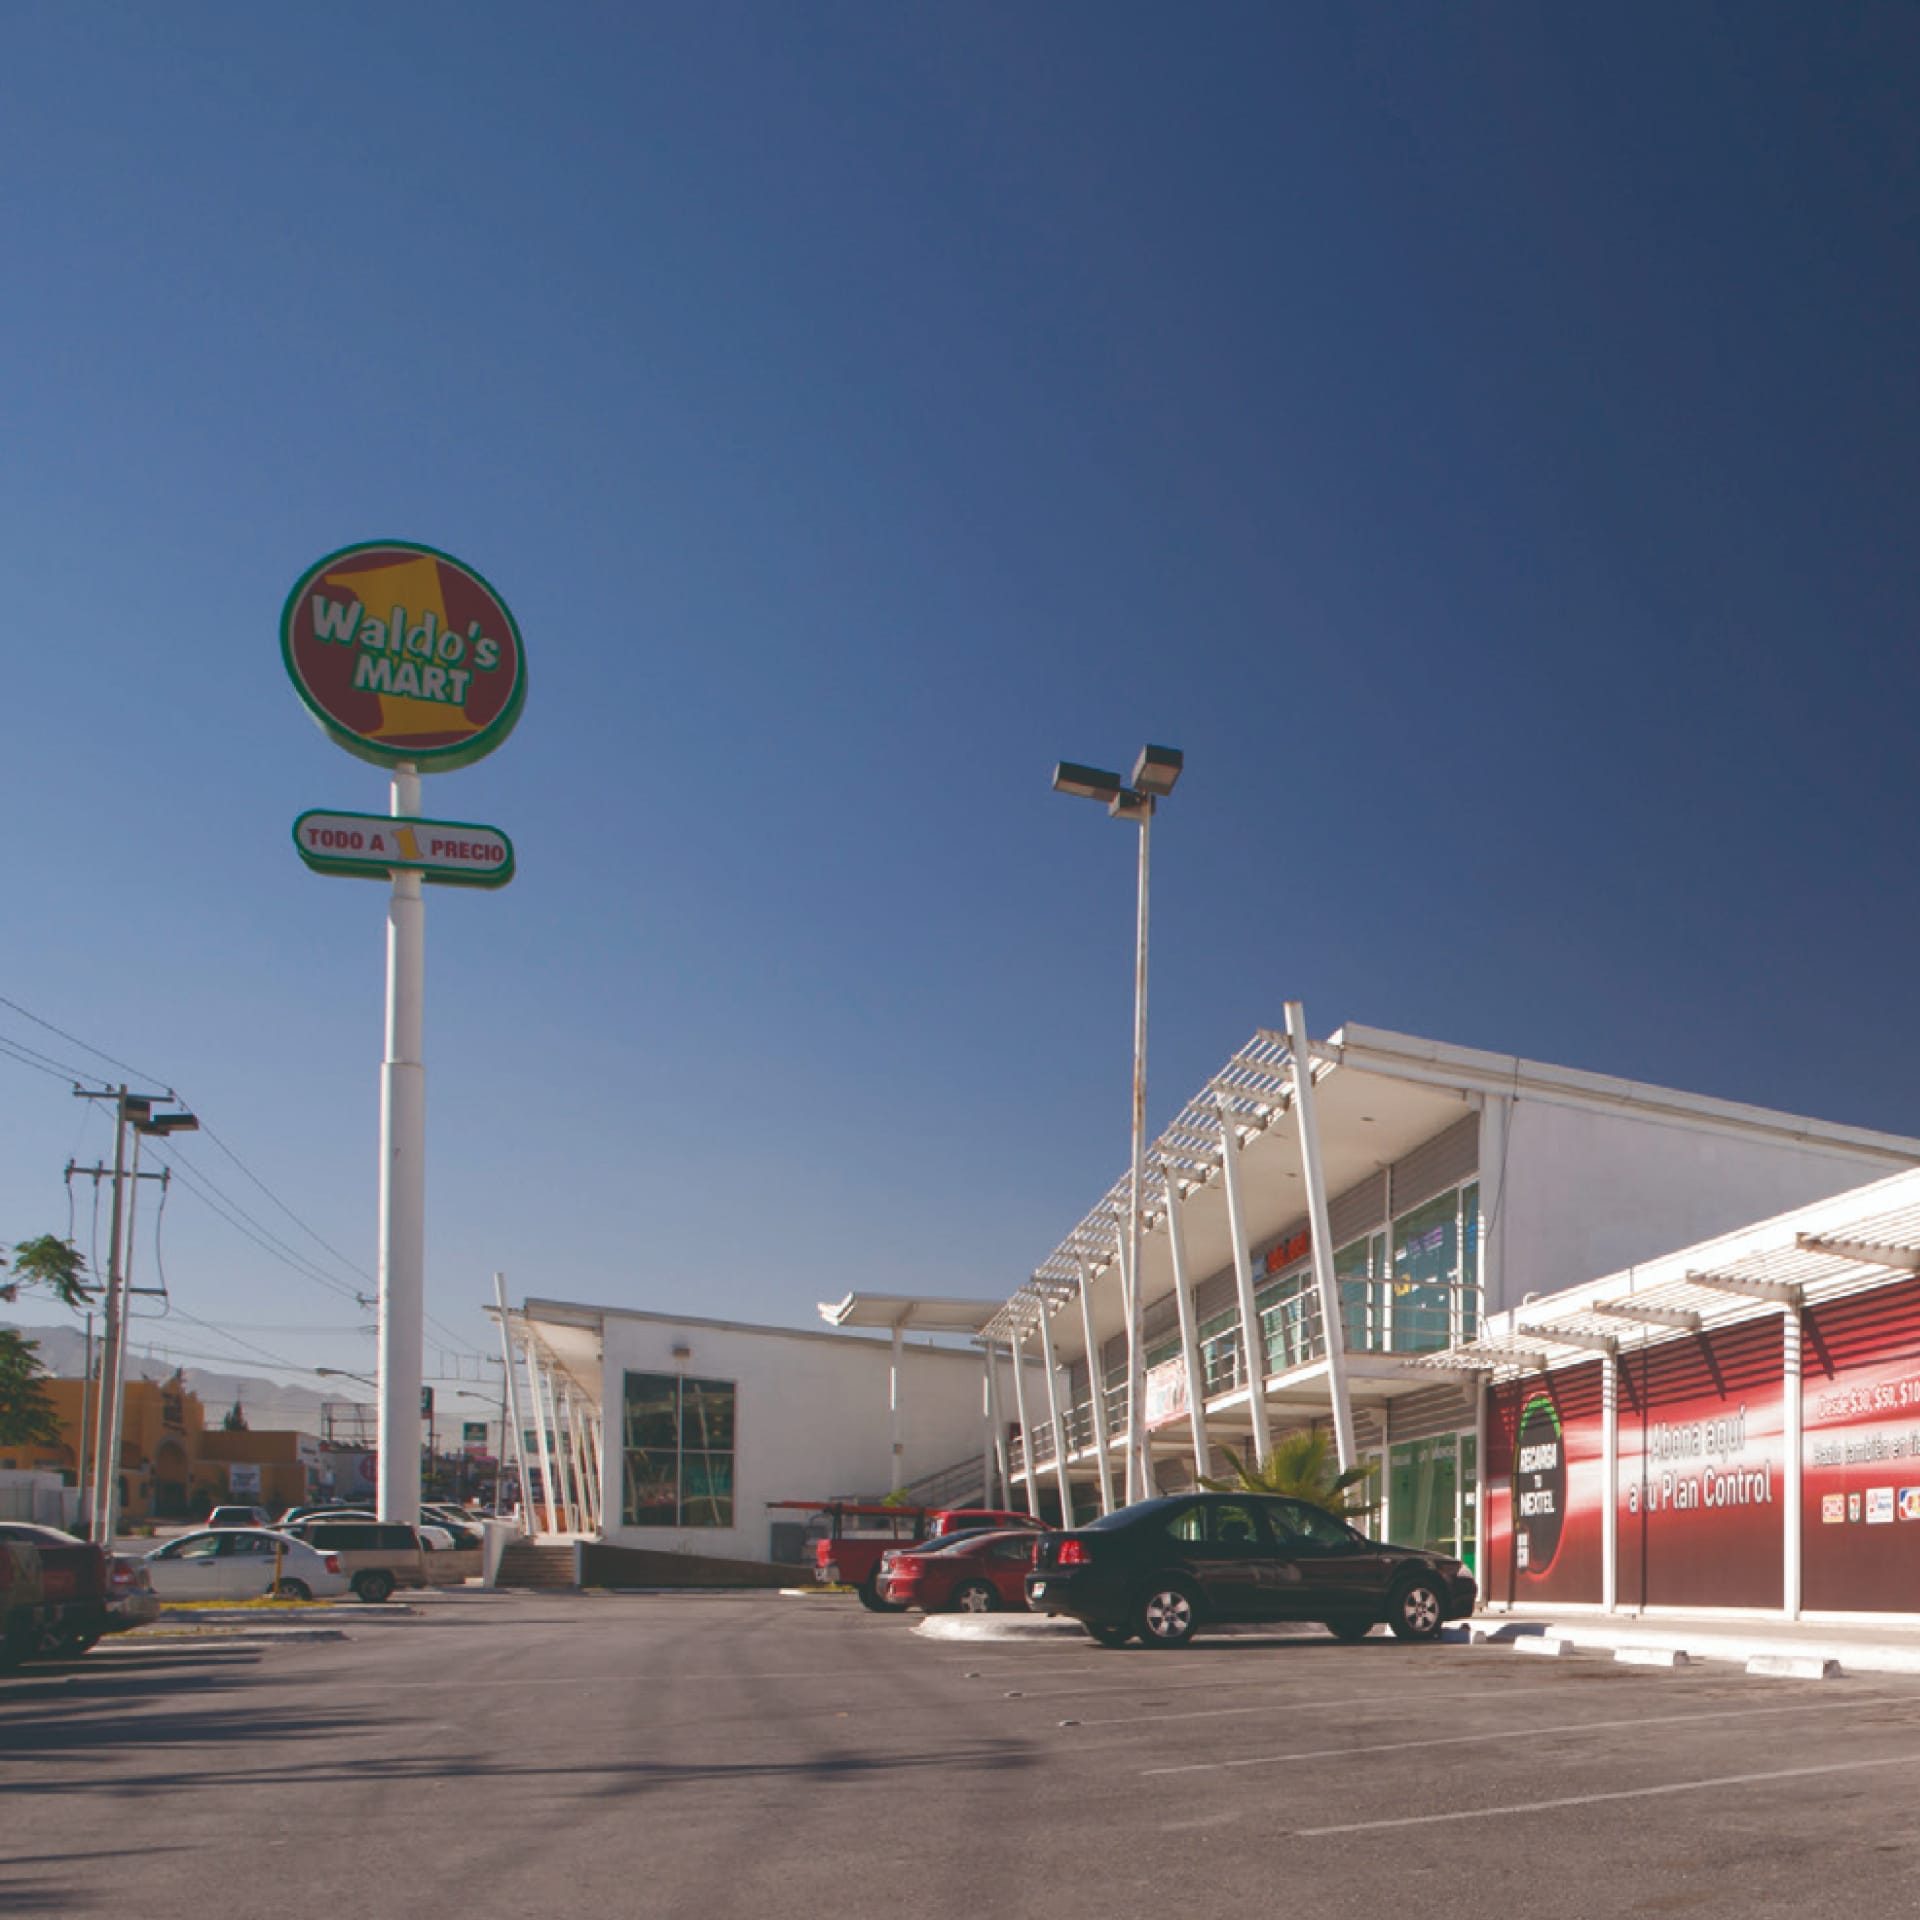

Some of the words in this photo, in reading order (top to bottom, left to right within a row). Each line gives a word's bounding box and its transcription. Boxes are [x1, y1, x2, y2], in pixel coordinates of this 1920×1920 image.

[311, 594, 501, 670] Waldo's
[353, 654, 471, 704] MART
[308, 828, 364, 850] TODO
[369, 837, 385, 852] A
[431, 839, 505, 862] PRECIO
[1650, 1421, 1701, 1462] Abona
[1705, 1402, 1746, 1463] aquí
[1520, 1490, 1556, 1517] NEXTEL
[1629, 1483, 1639, 1513] a
[1643, 1482, 1658, 1511] u
[1661, 1470, 1699, 1510] Plan
[1703, 1459, 1772, 1508] Control
